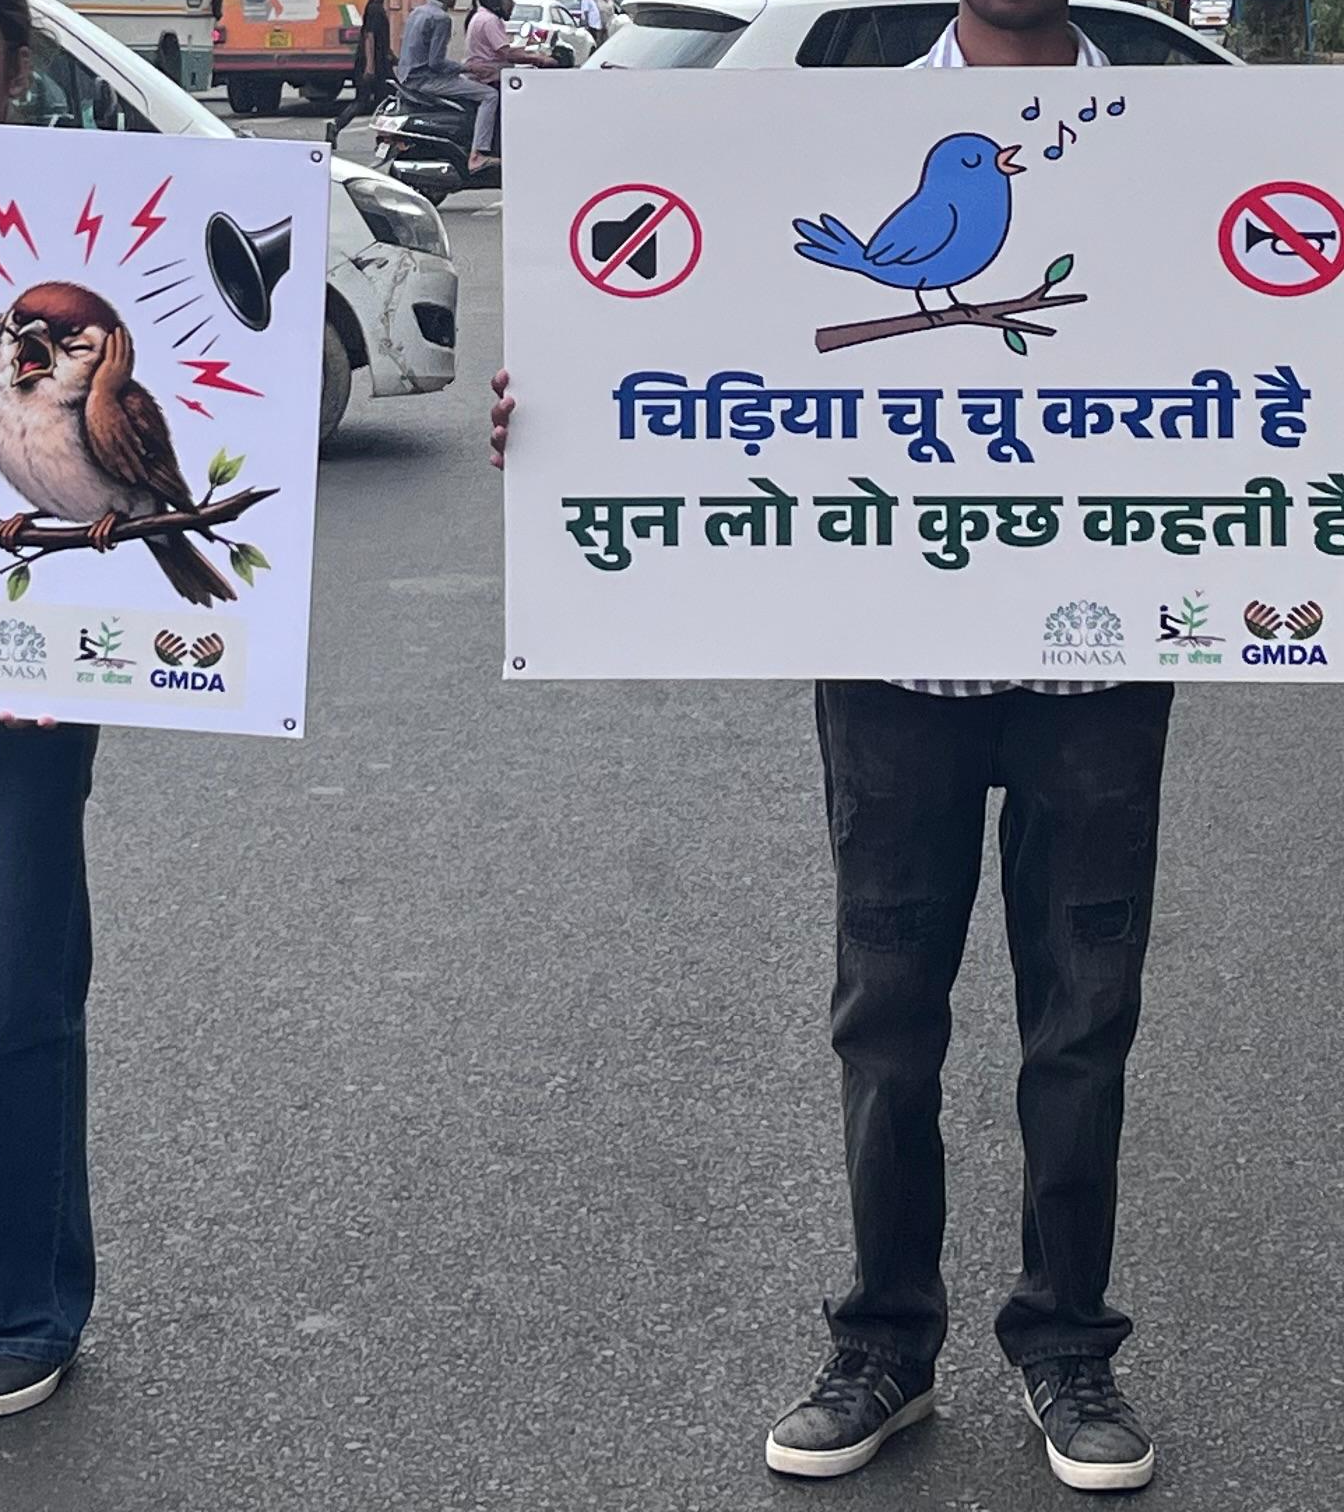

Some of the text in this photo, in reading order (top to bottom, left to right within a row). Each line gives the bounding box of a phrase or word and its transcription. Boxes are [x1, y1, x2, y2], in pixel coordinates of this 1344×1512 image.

[613, 366, 1311, 463] चिड़िया चू चू करती है
[562, 497, 685, 571] सुन
[700, 478, 798, 546] लो
[813, 478, 899, 545] वो
[913, 496, 1063, 570] कुछ
[1078, 477, 1293, 555] कहती
[1042, 650, 1127, 666] HONASA
[1242, 644, 1328, 666] GMDA
[150, 669, 226, 693] GMDA
